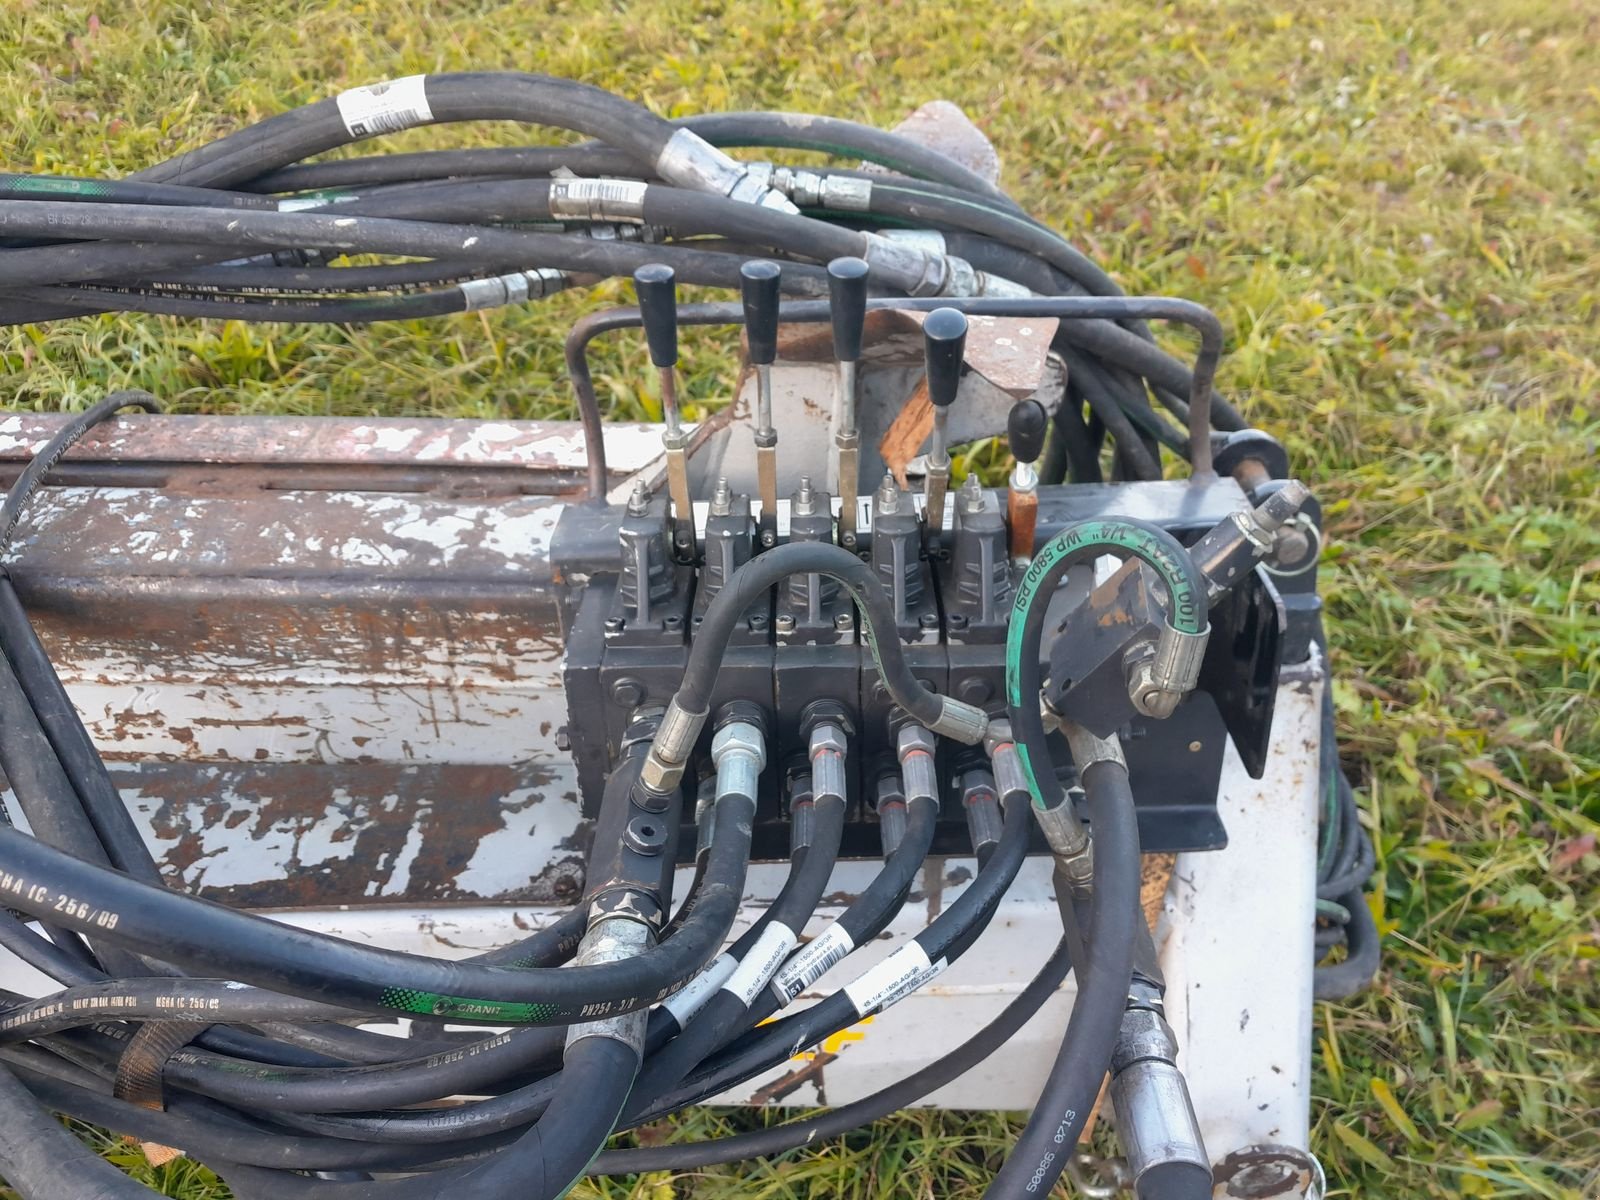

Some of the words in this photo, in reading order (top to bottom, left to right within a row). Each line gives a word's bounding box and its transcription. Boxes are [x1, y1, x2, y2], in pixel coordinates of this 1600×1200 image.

[1056, 529, 1082, 552] WP
[1026, 545, 1054, 583] 5800
[1014, 583, 1031, 613] PSI
[1178, 591, 1194, 626] 100
[0, 870, 22, 895] HA
[27, 882, 119, 930] IC-256/09
[790, 983, 802, 996] 51
[155, 996, 175, 1008] MSHA
[456, 1003, 502, 1015] GRANIT
[579, 1001, 612, 1017] PH254
[483, 1033, 512, 1051] MSHA
[1025, 1152, 1055, 1193] 50086
[1053, 1109, 1076, 1144] 0713
